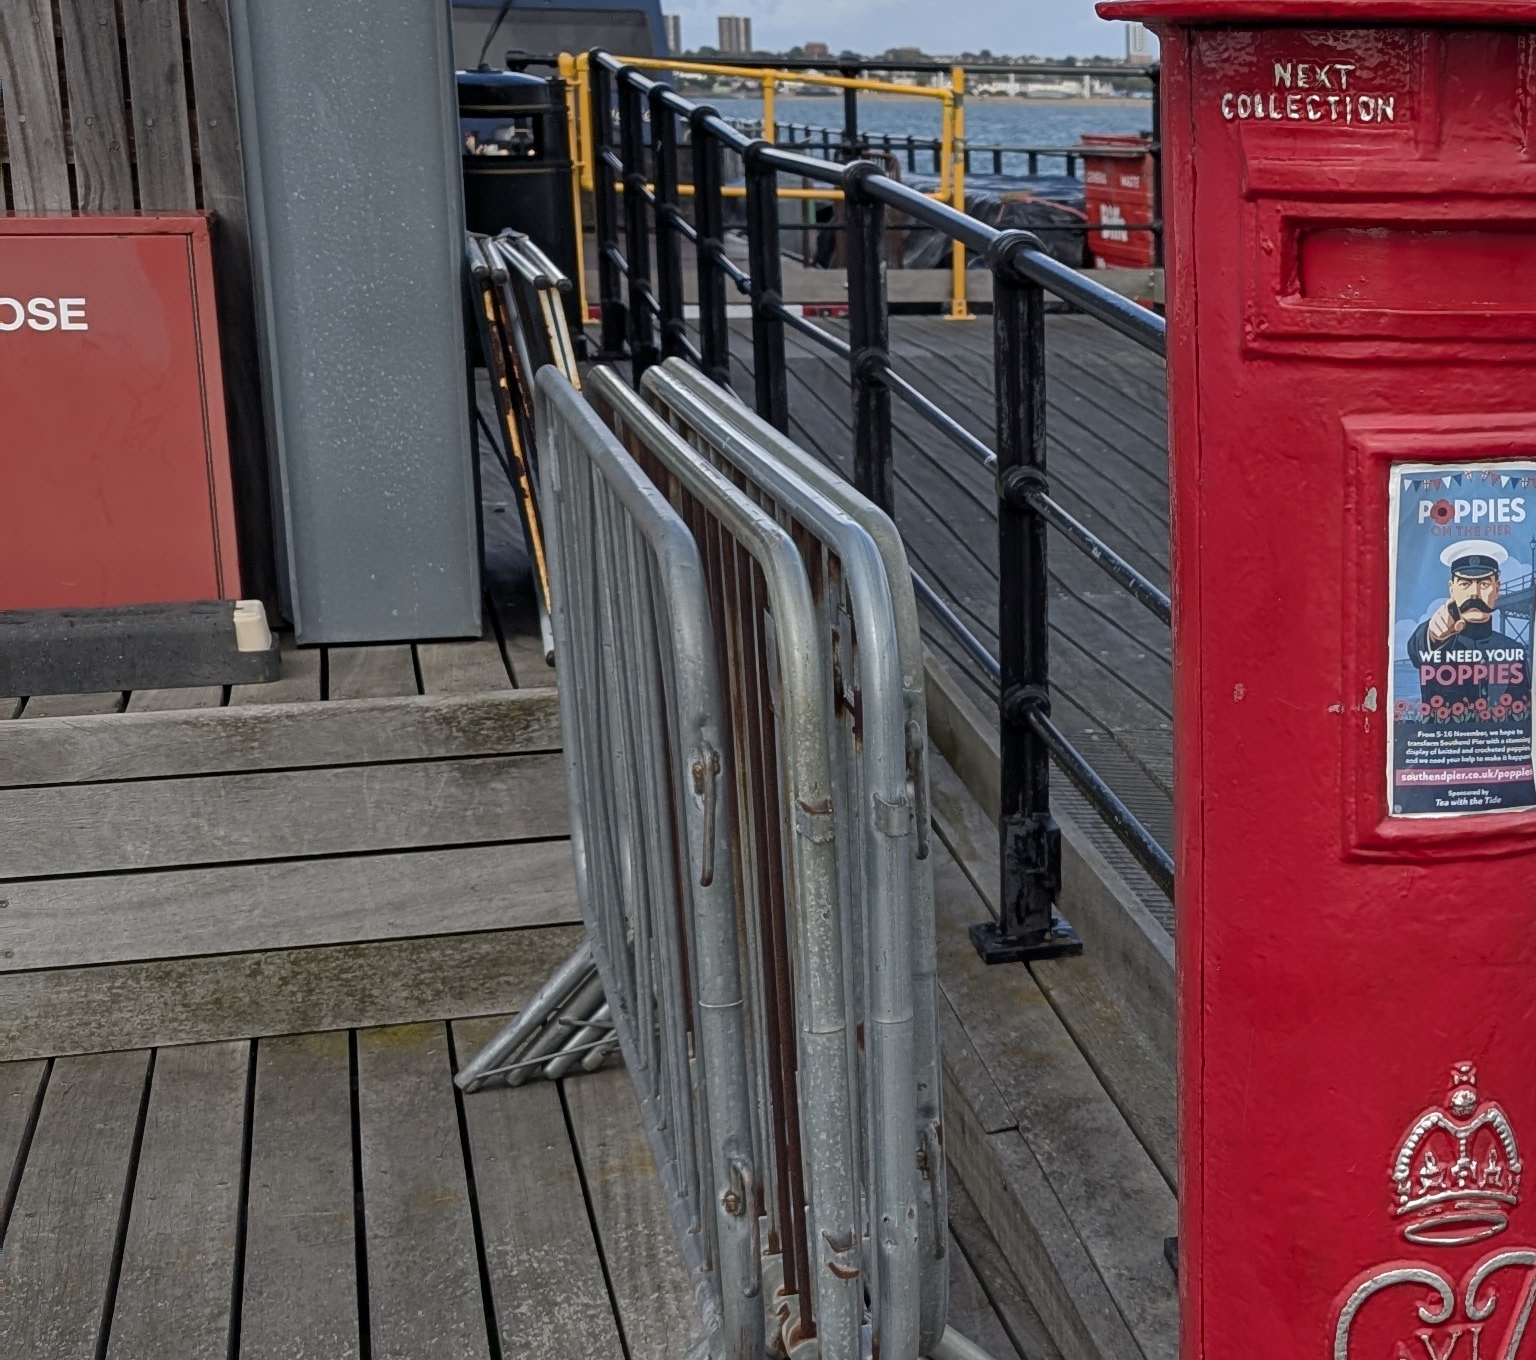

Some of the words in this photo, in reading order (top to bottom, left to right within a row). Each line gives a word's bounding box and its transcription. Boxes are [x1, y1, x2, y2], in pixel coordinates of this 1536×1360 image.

[1274, 63, 1356, 89] NEXT
[1221, 92, 1396, 123] COLLECTION
[1456, 525, 1481, 537] THE
[1485, 524, 1512, 536] PIER
[1419, 650, 1442, 663] WE
[1445, 649, 1483, 663] NEED
[1485, 648, 1525, 661] YOUR
[1420, 663, 1524, 686] POPPIES
[1401, 768, 1533, 782] southendpier.co.uk/poppies
